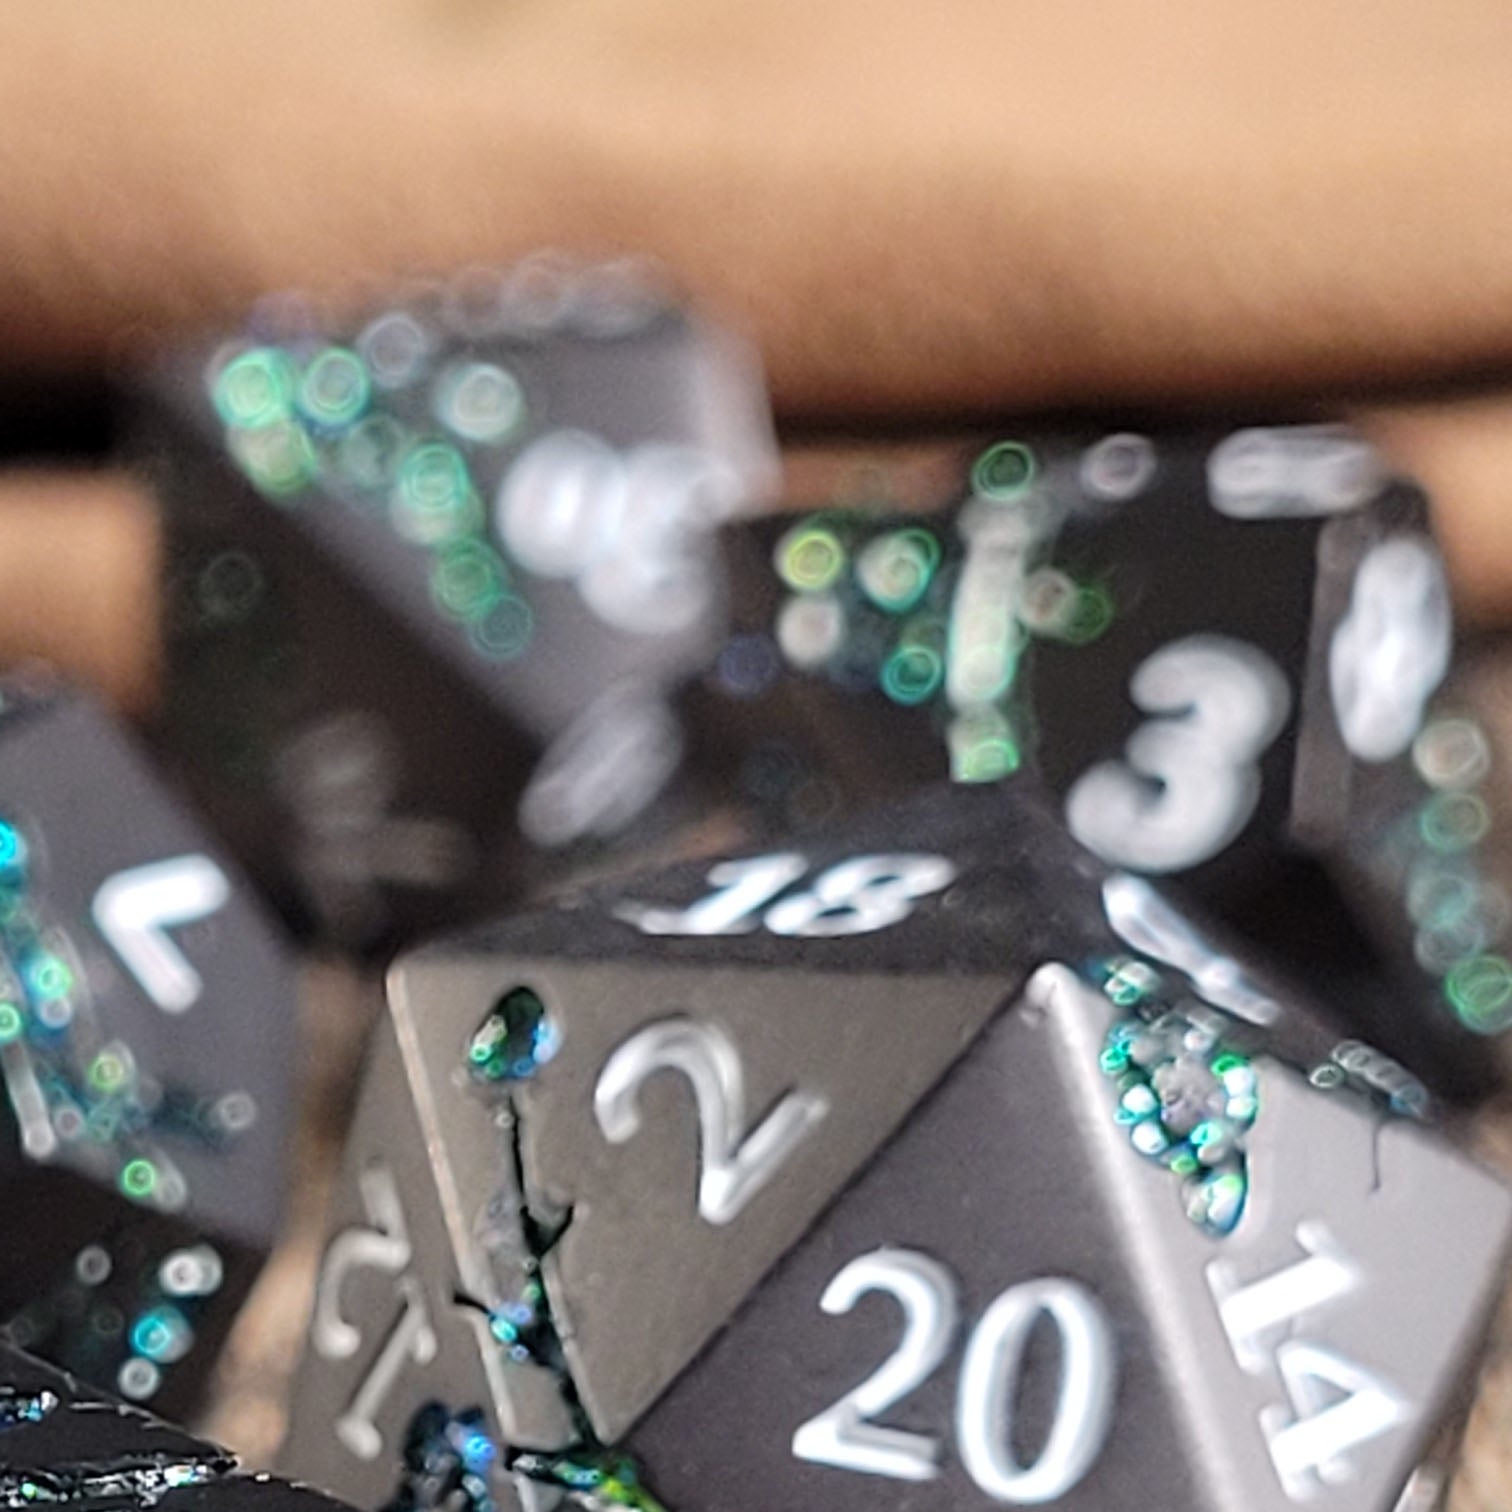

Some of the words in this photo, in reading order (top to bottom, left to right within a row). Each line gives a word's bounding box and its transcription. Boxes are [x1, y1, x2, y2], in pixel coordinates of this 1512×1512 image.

[1066, 634, 1292, 871] 3
[623, 852, 955, 936] 18
[593, 1015, 831, 1225] 2
[791, 1247, 1116, 1503] 20
[1207, 1218, 1410, 1503] 14
